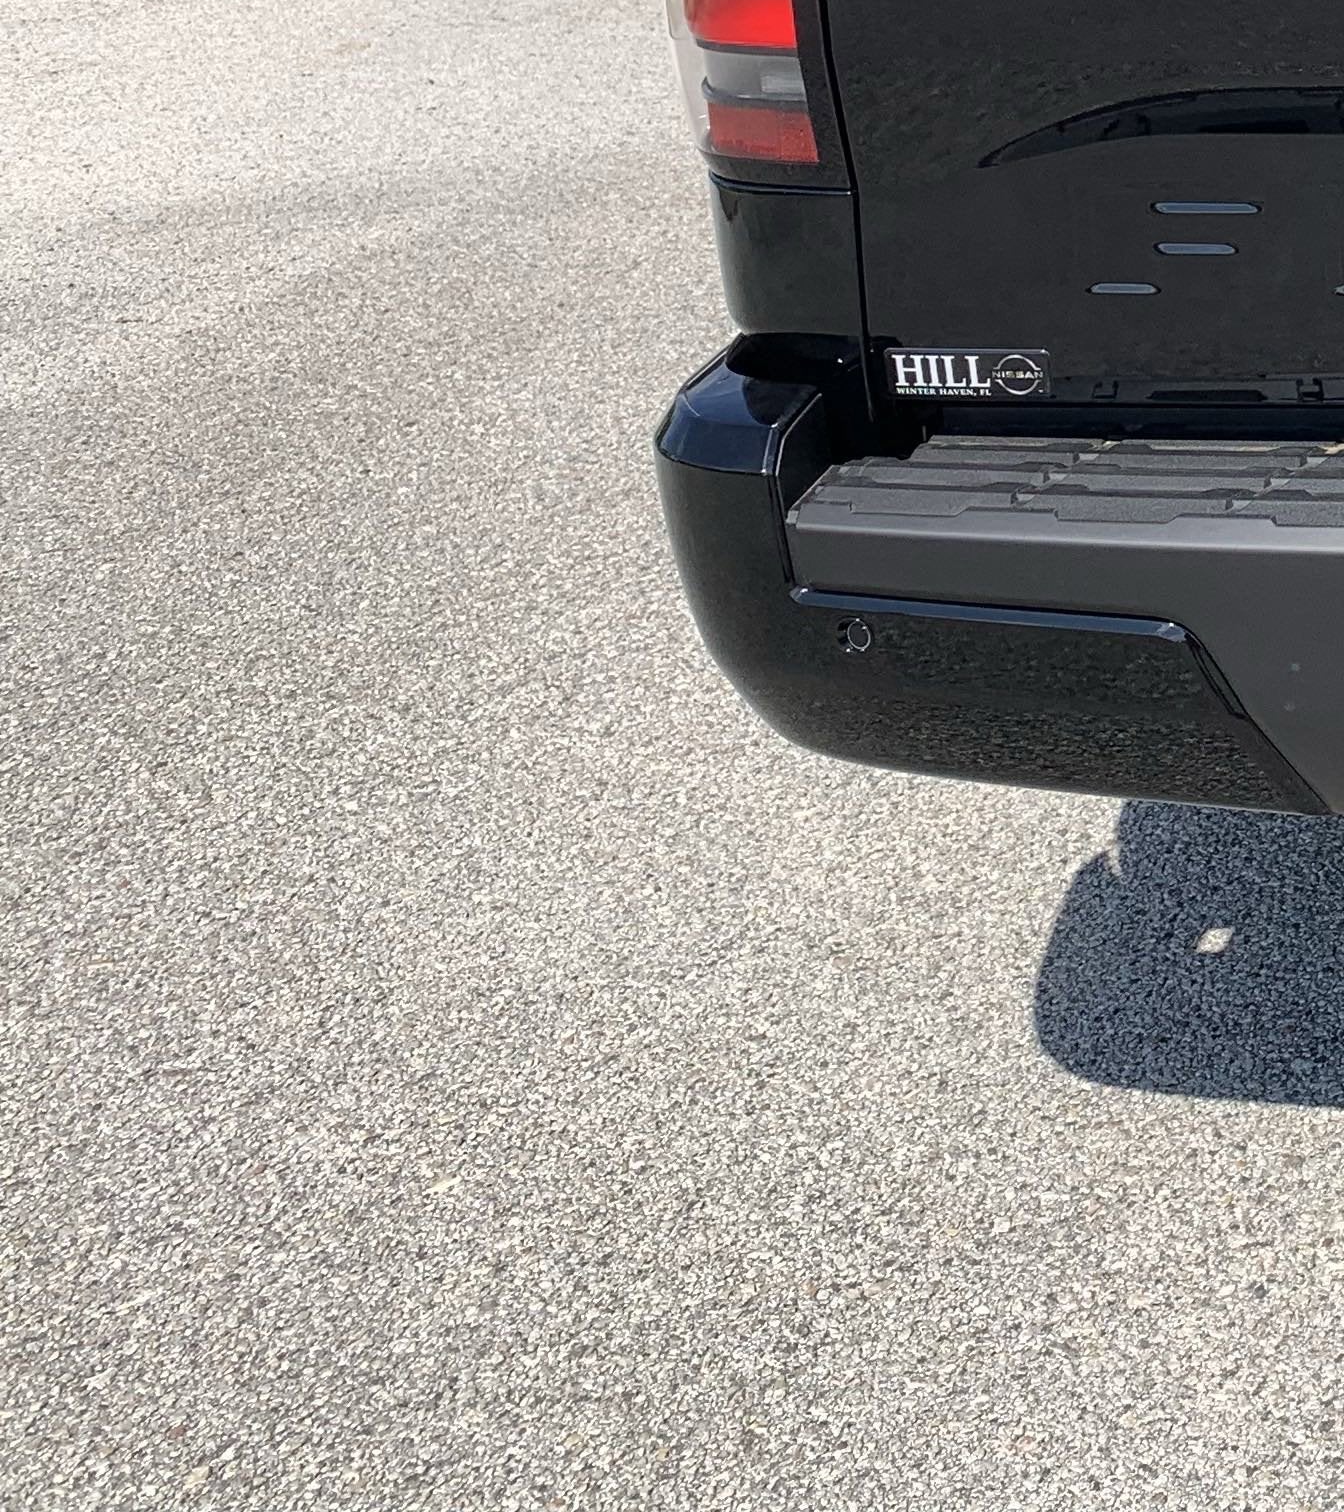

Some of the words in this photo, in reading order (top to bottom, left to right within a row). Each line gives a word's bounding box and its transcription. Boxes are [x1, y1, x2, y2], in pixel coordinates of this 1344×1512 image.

[891, 354, 991, 388] HILL
[992, 370, 1044, 380] NISSAN
[896, 387, 937, 396] WINTER
[939, 387, 977, 397] HAVEN,
[980, 388, 992, 397] FL
